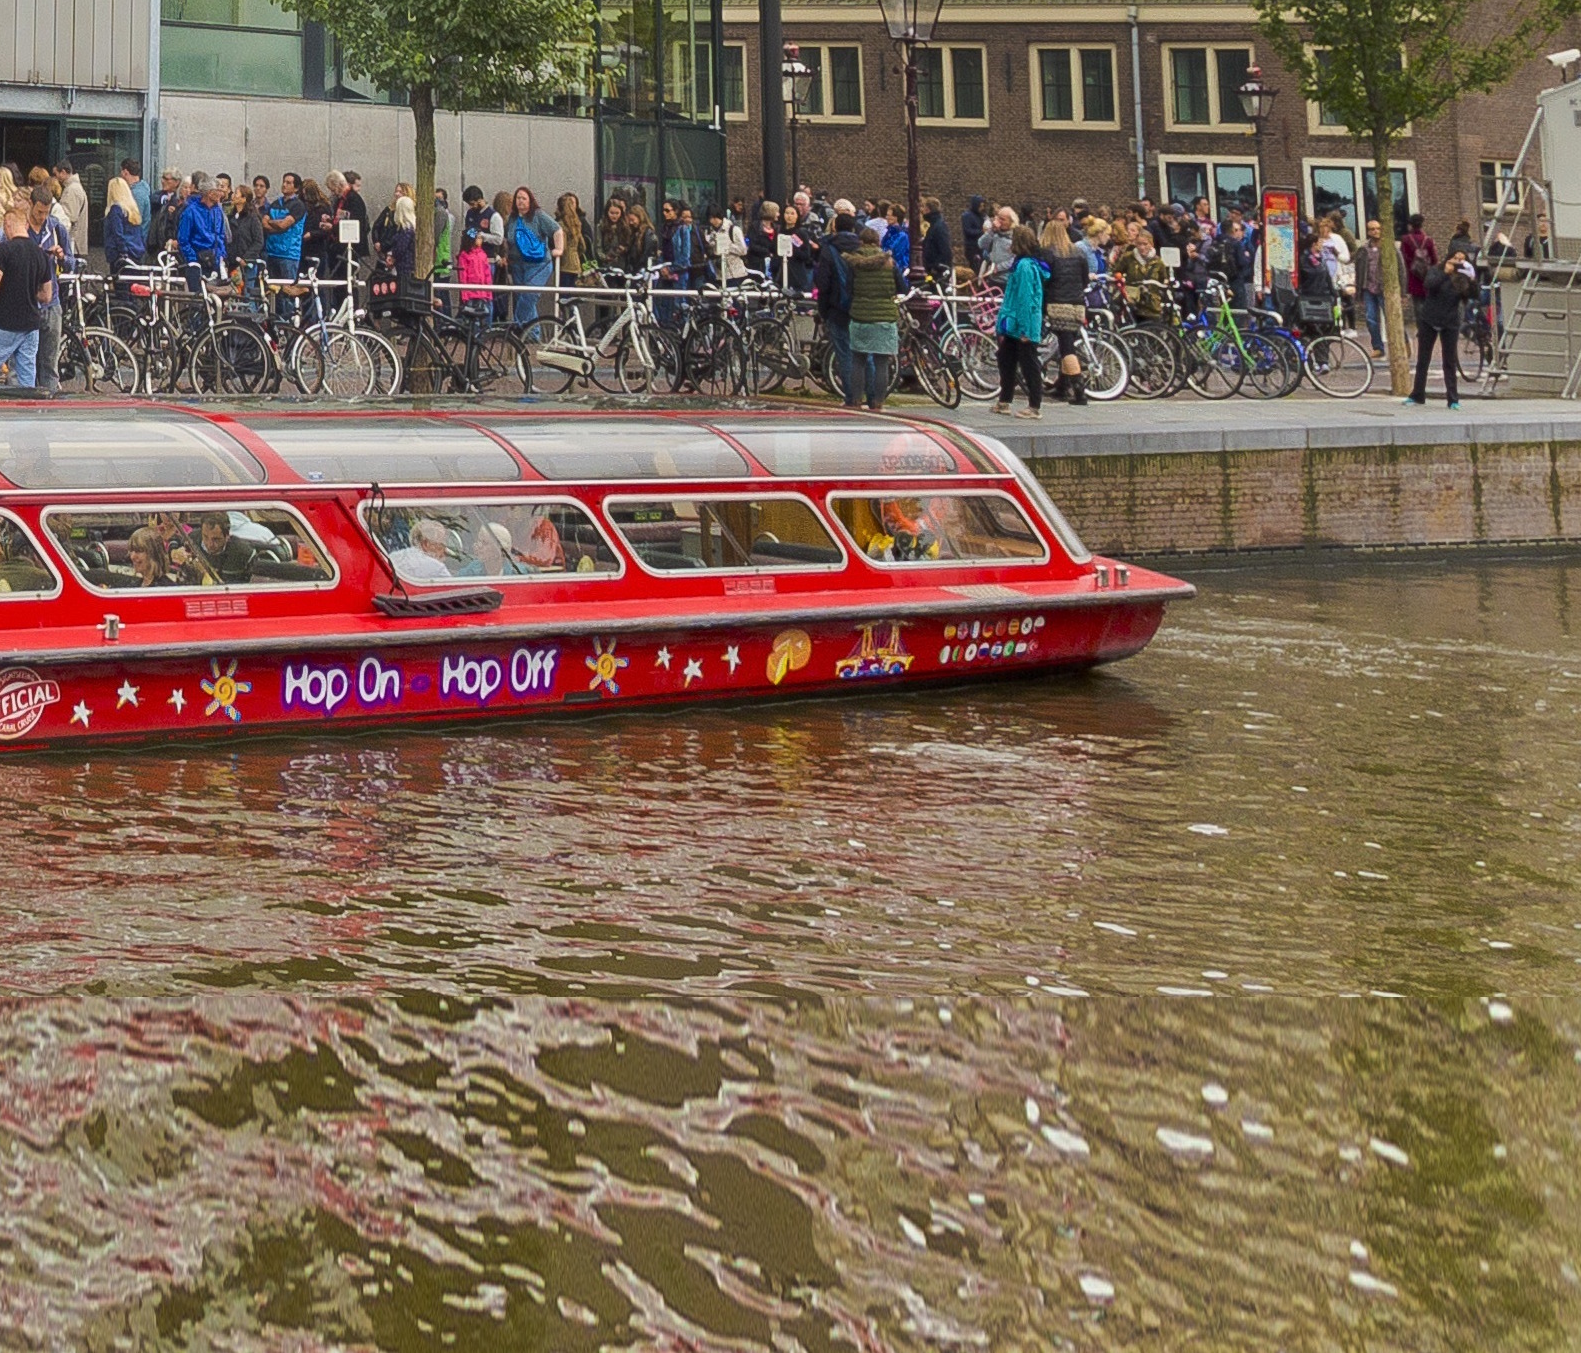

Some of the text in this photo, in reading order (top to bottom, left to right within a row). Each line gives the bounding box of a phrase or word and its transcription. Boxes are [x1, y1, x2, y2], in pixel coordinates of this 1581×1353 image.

[286, 648, 557, 710] Hop On Hop Off
